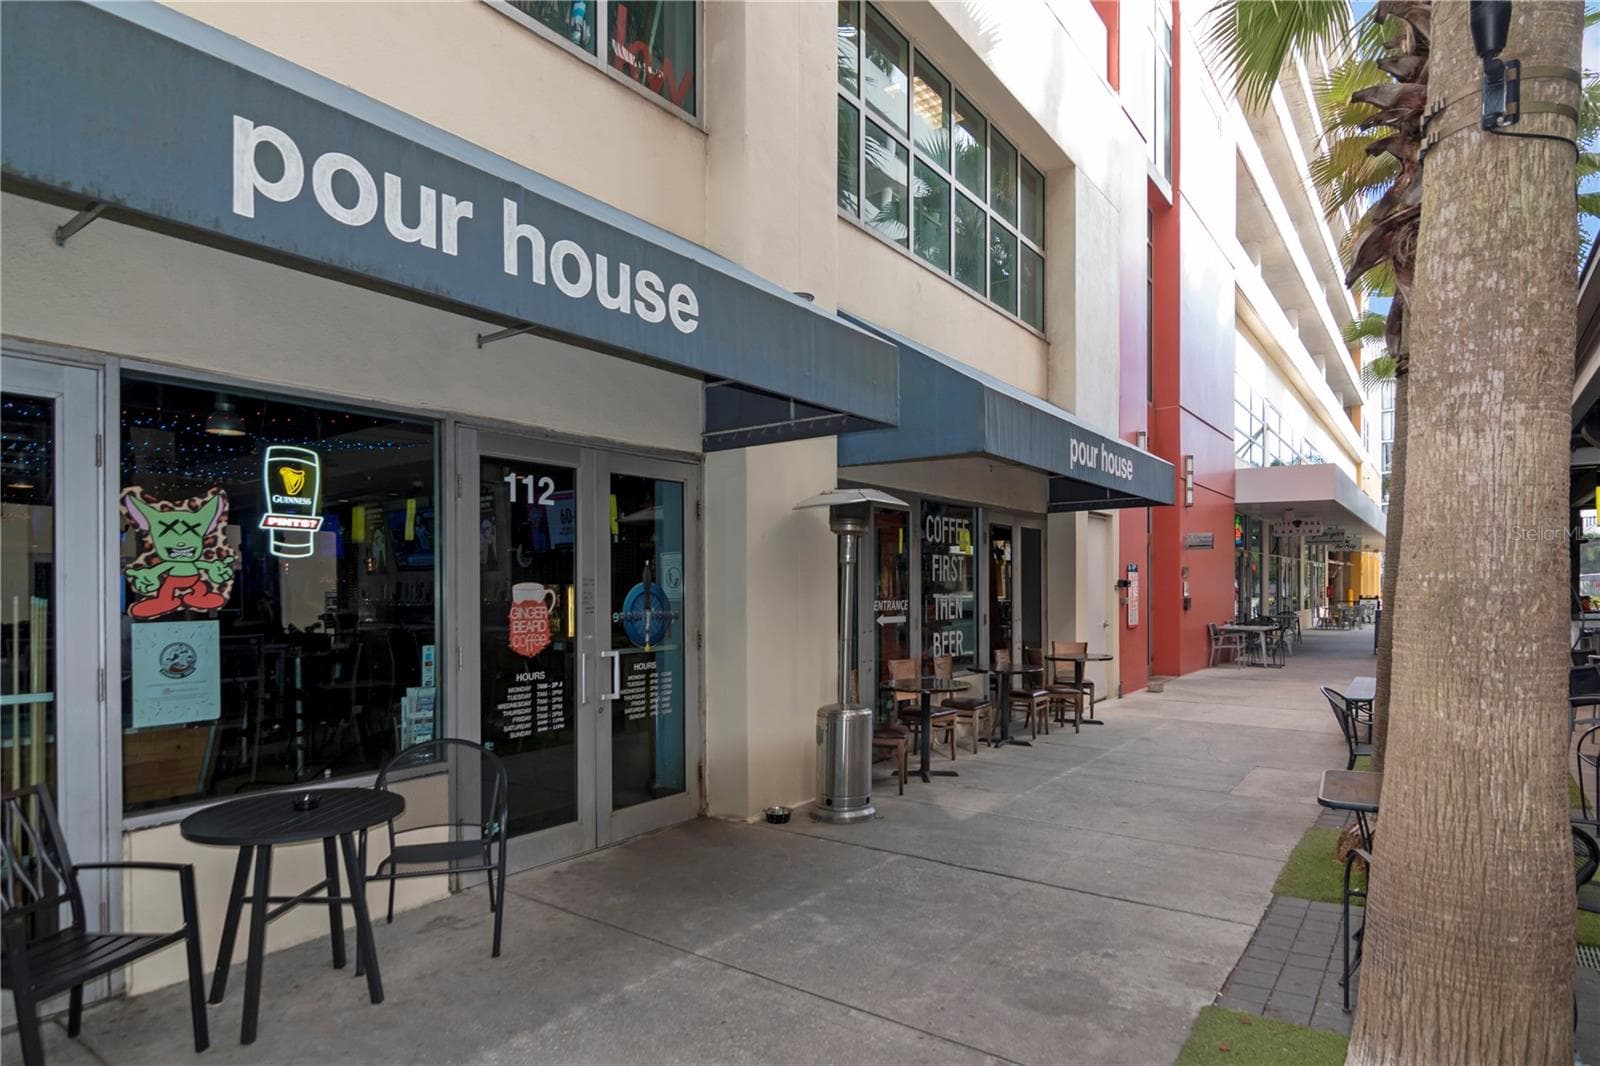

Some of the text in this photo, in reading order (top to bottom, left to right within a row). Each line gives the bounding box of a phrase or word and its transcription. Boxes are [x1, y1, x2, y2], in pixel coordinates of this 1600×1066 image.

[233, 115, 699, 334] pour house
[1070, 437, 1133, 480] pour house
[504, 472, 555, 506] 112
[272, 494, 312, 506] GUINNESS
[932, 554, 964, 582] FIRST
[873, 600, 909, 612] ENTRANCE
[933, 594, 963, 621] THEN
[511, 606, 548, 619] GINGER
[513, 620, 546, 633] BEARD
[513, 633, 546, 652] coffee
[932, 630, 965, 658] BEER
[633, 661, 657, 671] HOURS
[515, 671, 546, 682] HOURS
[507, 685, 532, 694] MONDAY
[506, 693, 532, 702] TUESDAY
[497, 700, 532, 710] WEDNESDAY
[502, 707, 532, 717] THURSDAY
[512, 715, 532, 724] FRIDAY
[503, 722, 532, 732] SATURDAY
[509, 730, 532, 739] SUNDAY
